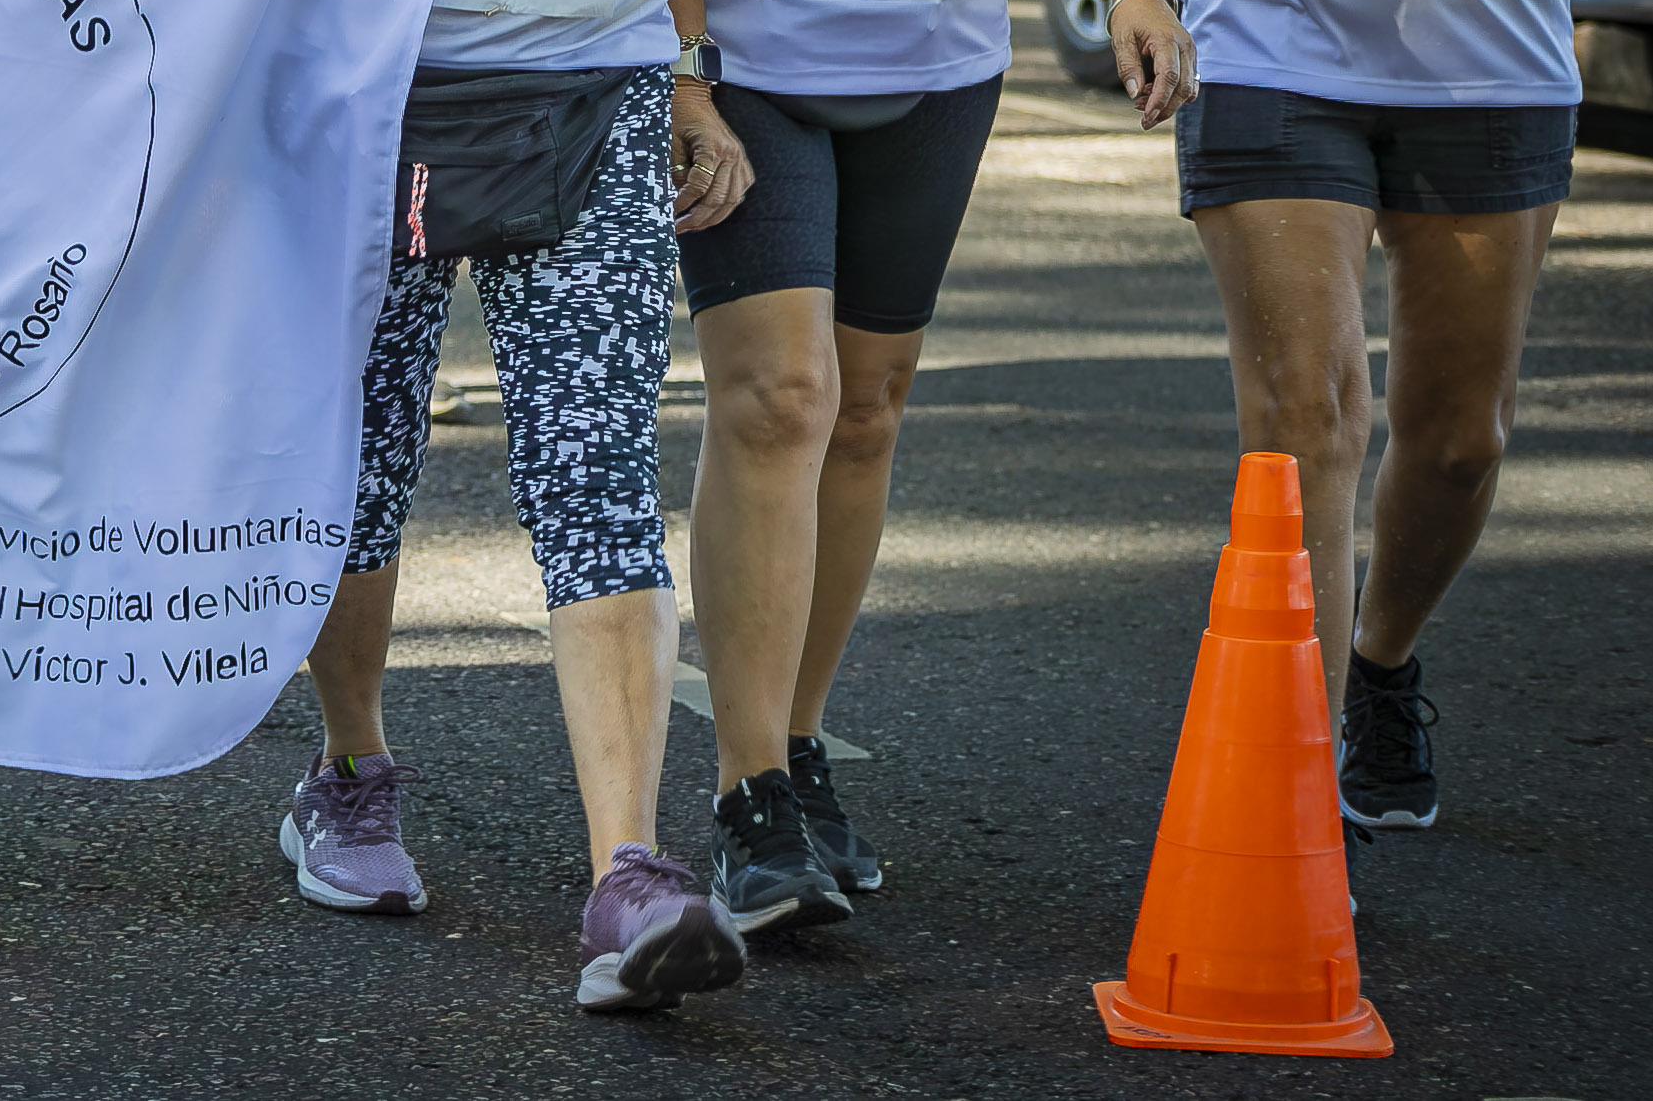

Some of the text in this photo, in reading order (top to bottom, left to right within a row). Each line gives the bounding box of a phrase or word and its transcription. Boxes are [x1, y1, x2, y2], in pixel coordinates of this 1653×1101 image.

[89, 515, 122, 553] de
[133, 508, 347, 556] Voluntarias
[15, 587, 152, 631] Hospital
[167, 586, 218, 622] de
[224, 575, 331, 617] Niños
[117, 653, 147, 686] J.
[161, 641, 268, 687] Vilela
